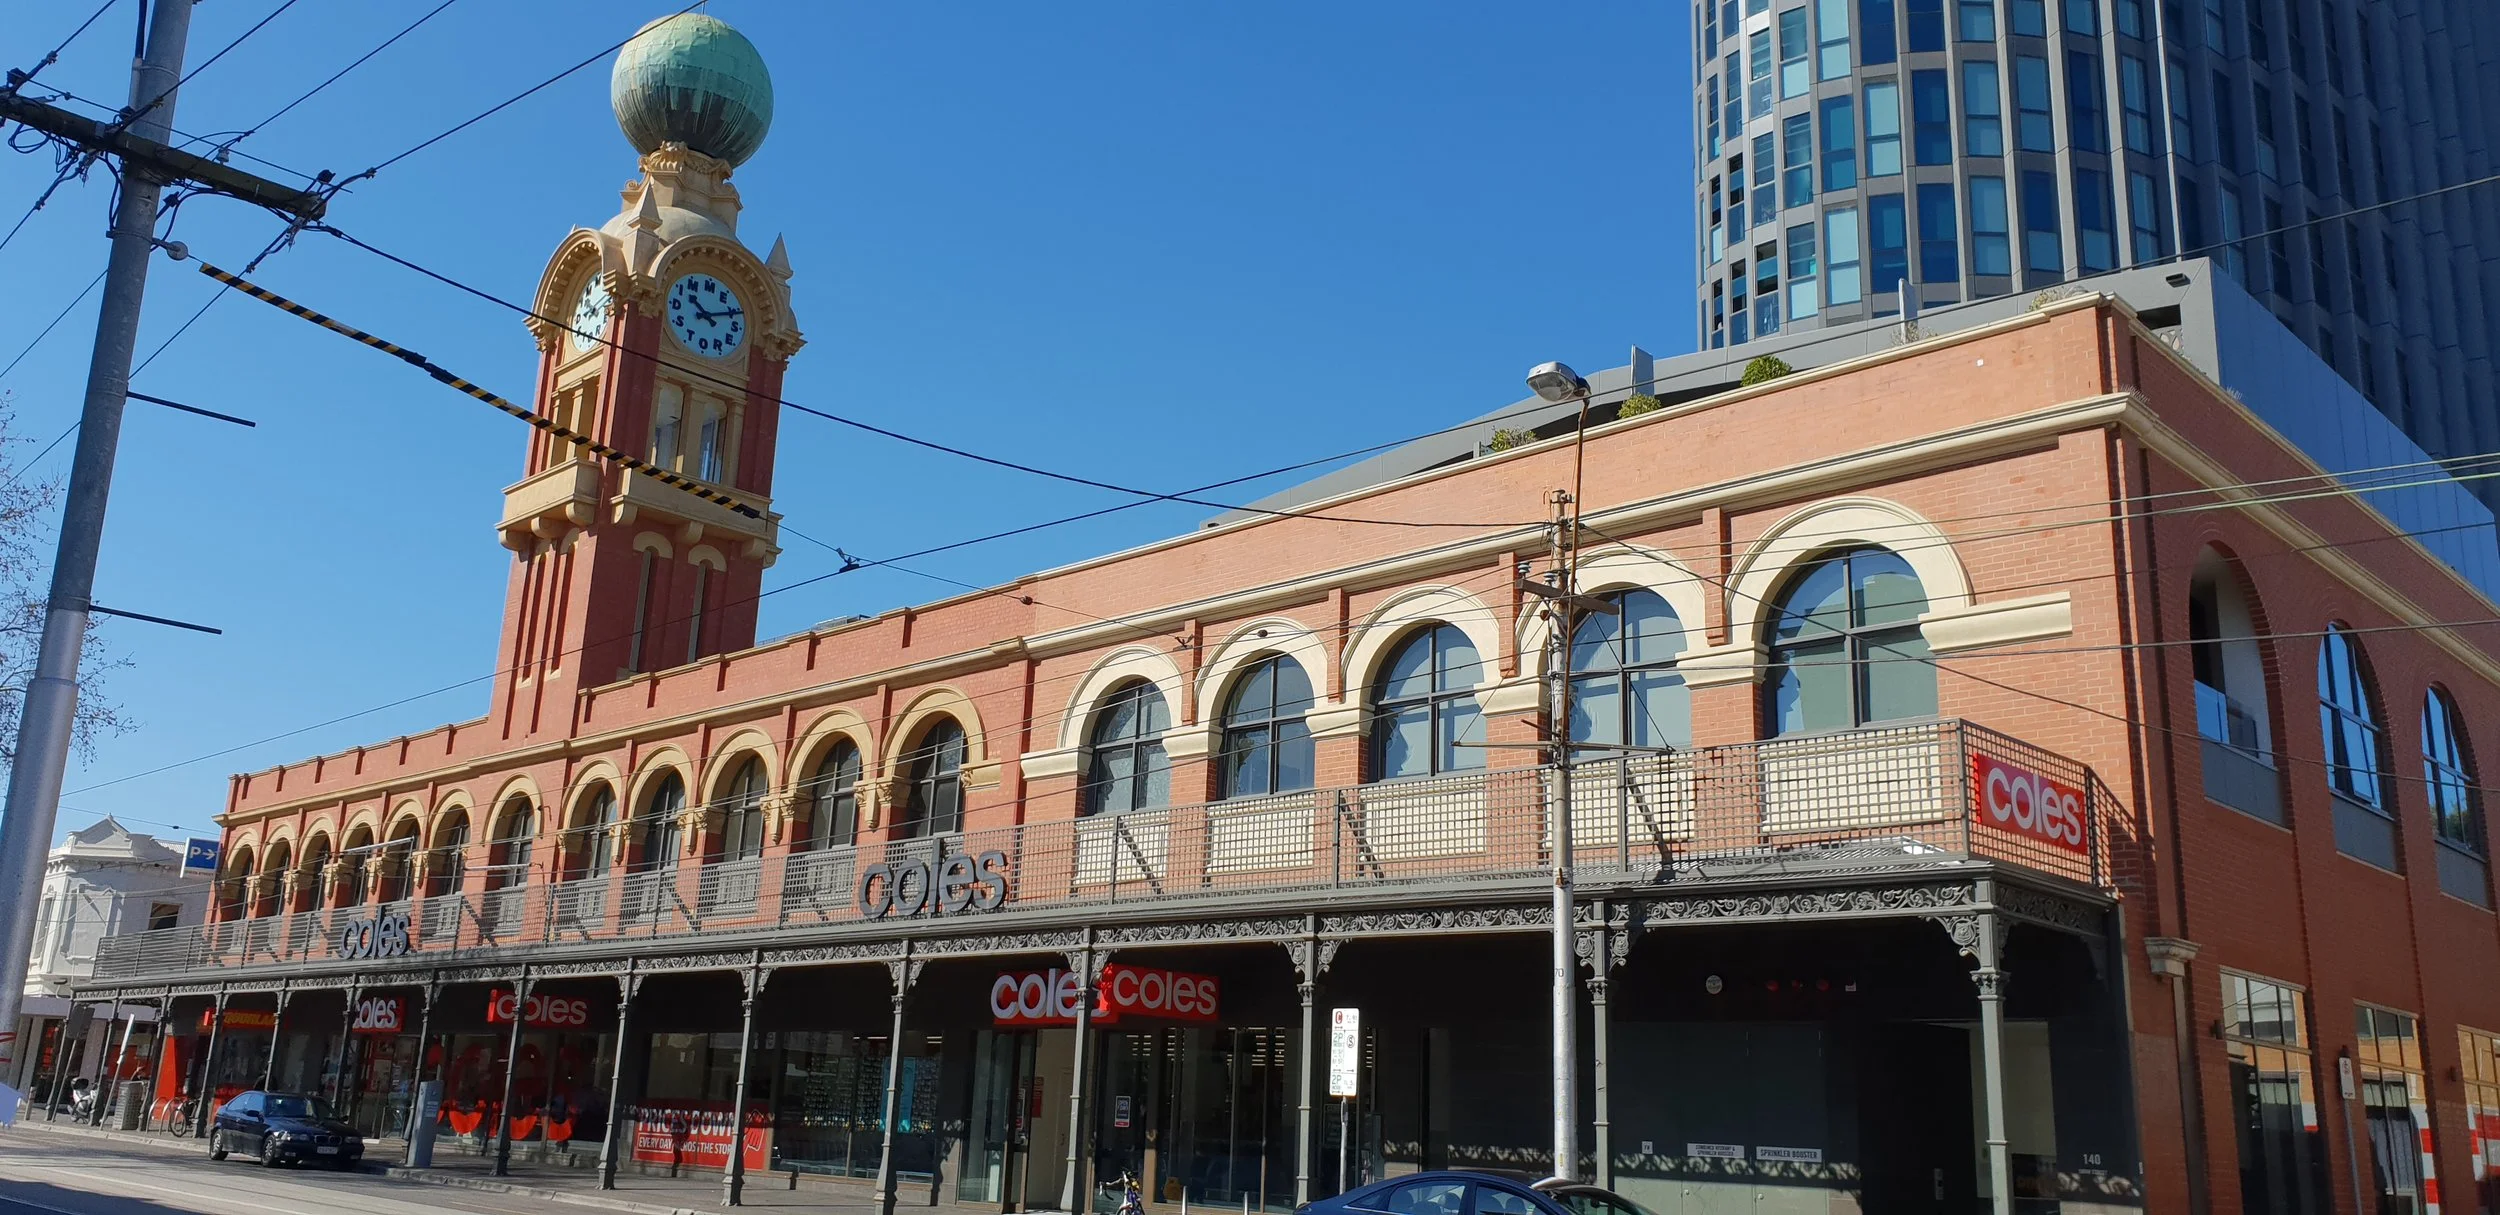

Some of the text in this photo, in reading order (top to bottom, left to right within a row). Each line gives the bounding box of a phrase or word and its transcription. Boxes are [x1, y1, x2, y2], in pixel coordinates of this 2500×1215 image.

[672, 278, 739, 333] DIMMEYS
[675, 315, 734, 352] STORE
[1987, 767, 2082, 846] coles
[190, 846, 202, 859] P
[859, 838, 1008, 920] coles
[339, 904, 411, 961] coles
[1113, 969, 1219, 1016] coles
[1331, 1074, 1342, 1085] 2P
[638, 1108, 688, 1134] PRICES
[638, 1136, 673, 1150] EVERY DAY
[700, 1142, 714, 1154] THE
[1760, 1149, 1818, 1160] SPRINKLER BOOSTER
[2083, 1153, 2102, 1166] 140
